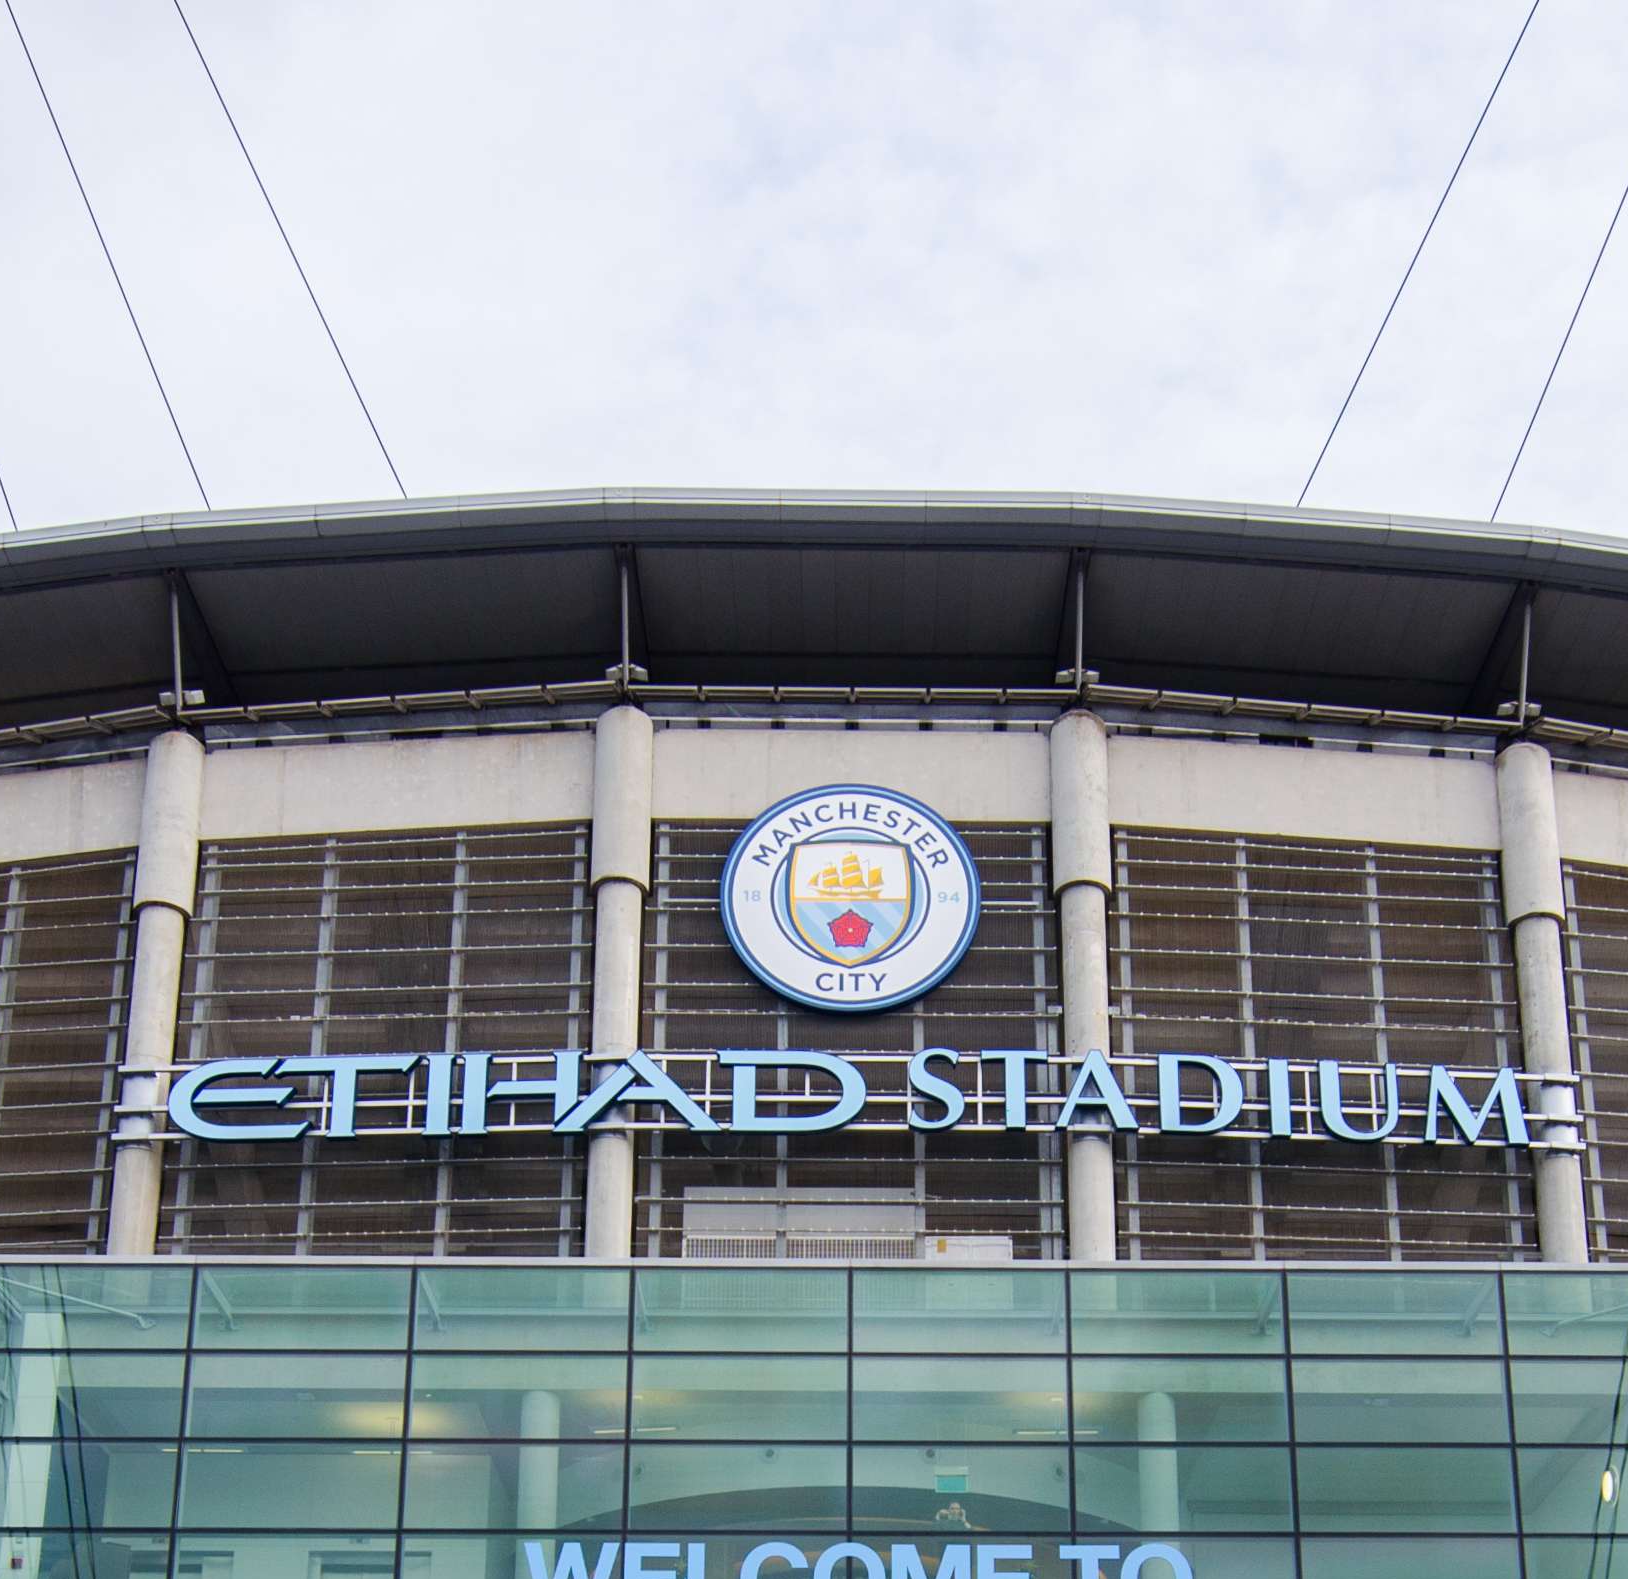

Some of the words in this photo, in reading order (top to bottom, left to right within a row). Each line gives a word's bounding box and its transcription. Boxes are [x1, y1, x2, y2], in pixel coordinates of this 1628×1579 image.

[751, 801, 950, 869] MANCHESTER
[743, 889, 761, 902] 18
[937, 891, 961, 904] 94
[815, 972, 889, 992] CITY
[167, 1048, 868, 1142] ETIHAD
[906, 1047, 1530, 1149] STADIUM
